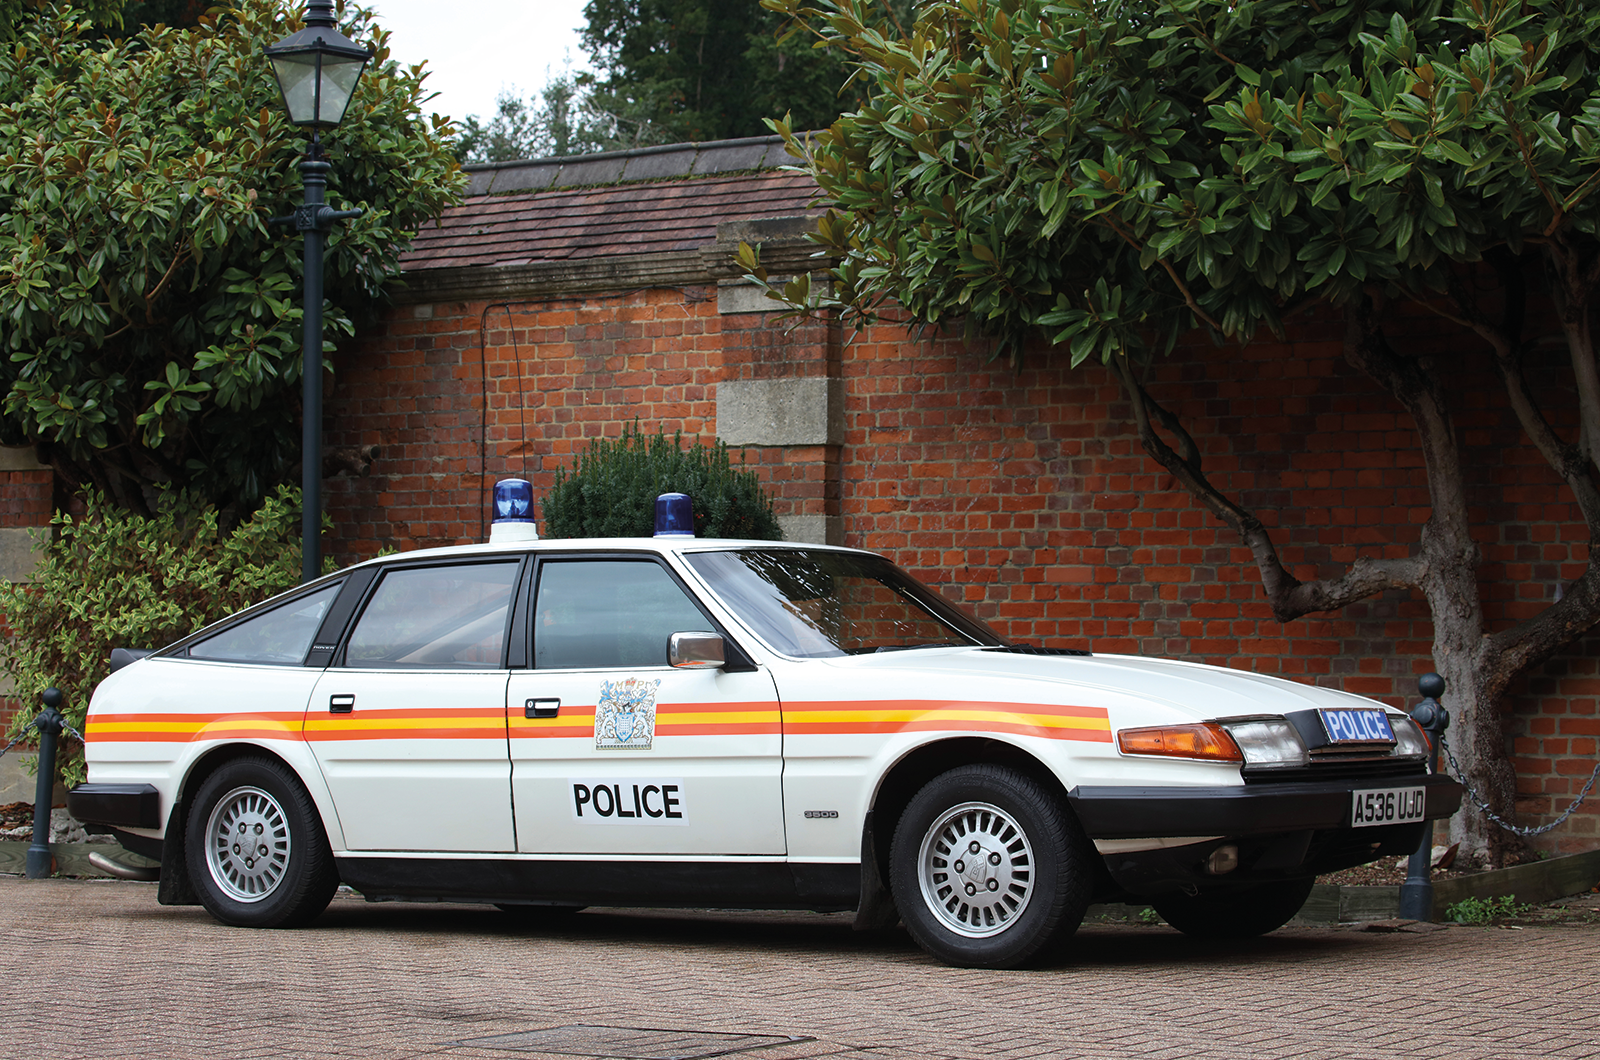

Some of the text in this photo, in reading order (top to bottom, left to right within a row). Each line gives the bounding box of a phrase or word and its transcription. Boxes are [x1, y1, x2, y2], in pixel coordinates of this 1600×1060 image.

[615, 680, 645, 690] M P
[1325, 711, 1389, 740] POLICE
[573, 784, 683, 818] POLICE
[804, 810, 839, 819] 3500
[1354, 790, 1424, 823] A536 UJD
